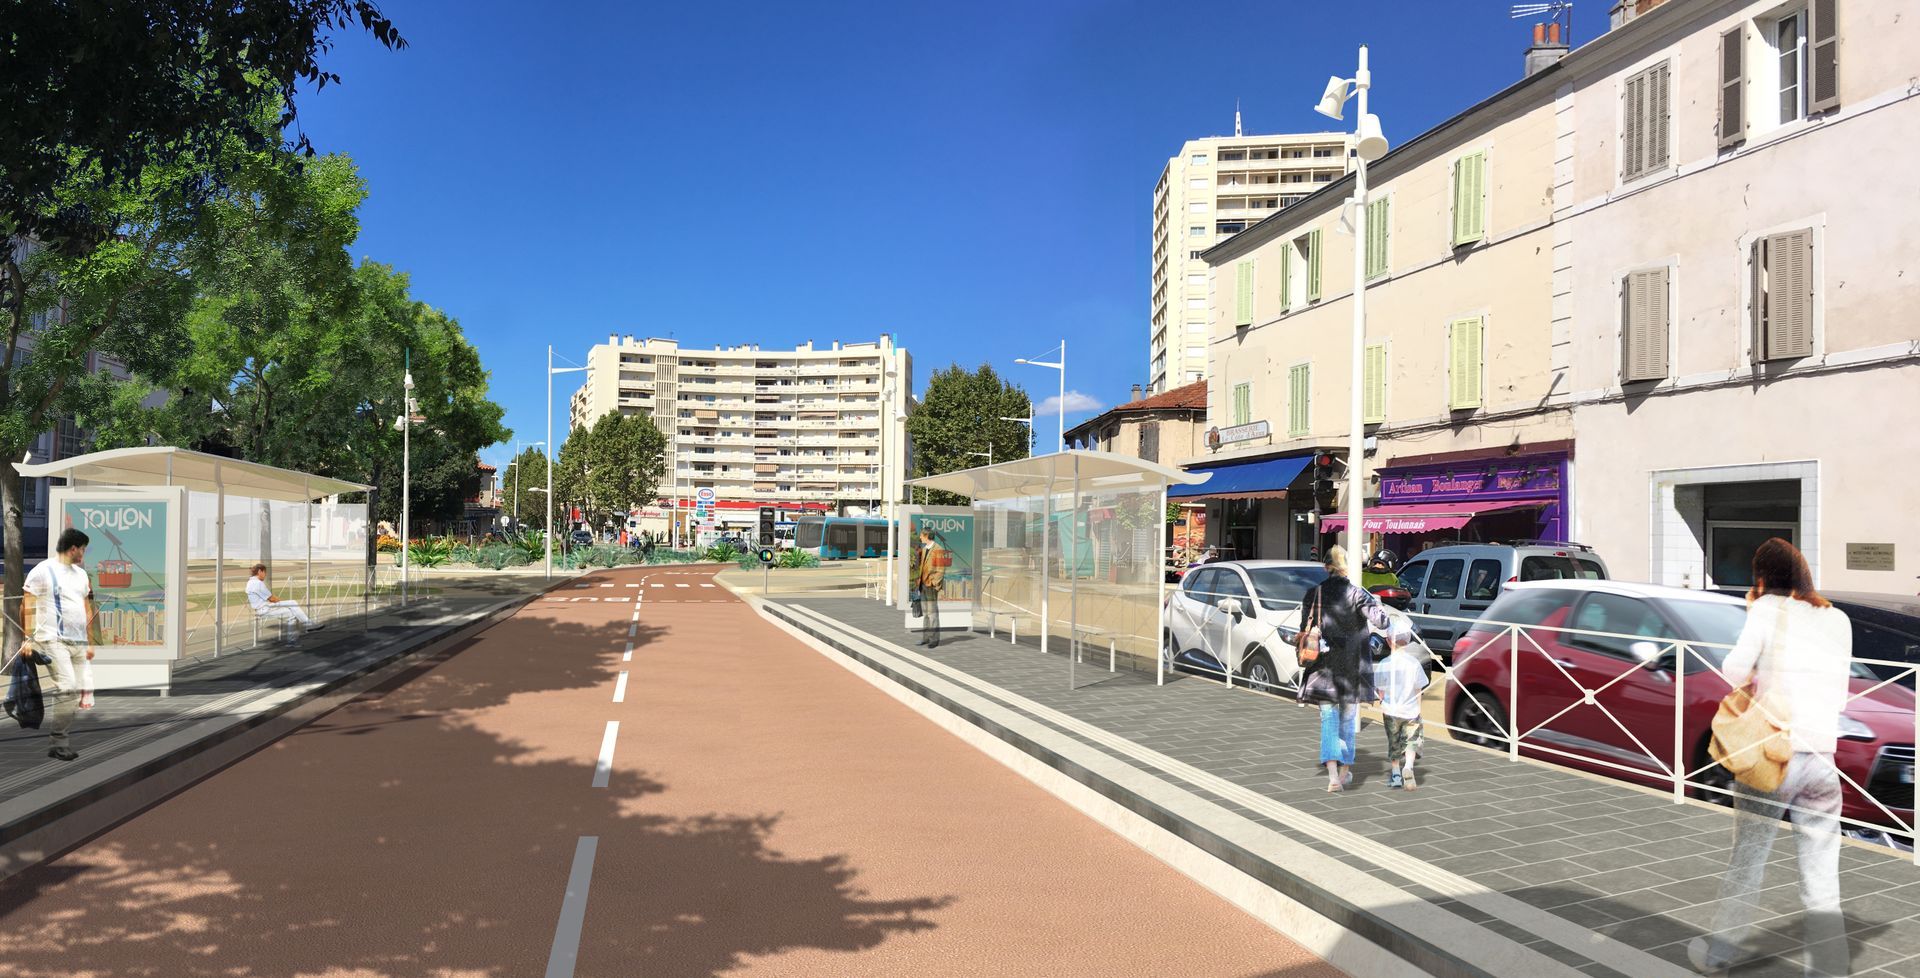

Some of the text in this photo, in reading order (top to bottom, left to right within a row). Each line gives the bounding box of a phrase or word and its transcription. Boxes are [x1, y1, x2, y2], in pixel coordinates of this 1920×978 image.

[1389, 479, 1423, 494] Artisan
[1431, 479, 1483, 495] Boulanger
[80, 507, 152, 531] TOULON
[920, 518, 965, 533] TOULON
[1363, 519, 1425, 530] Four Toulonnais
